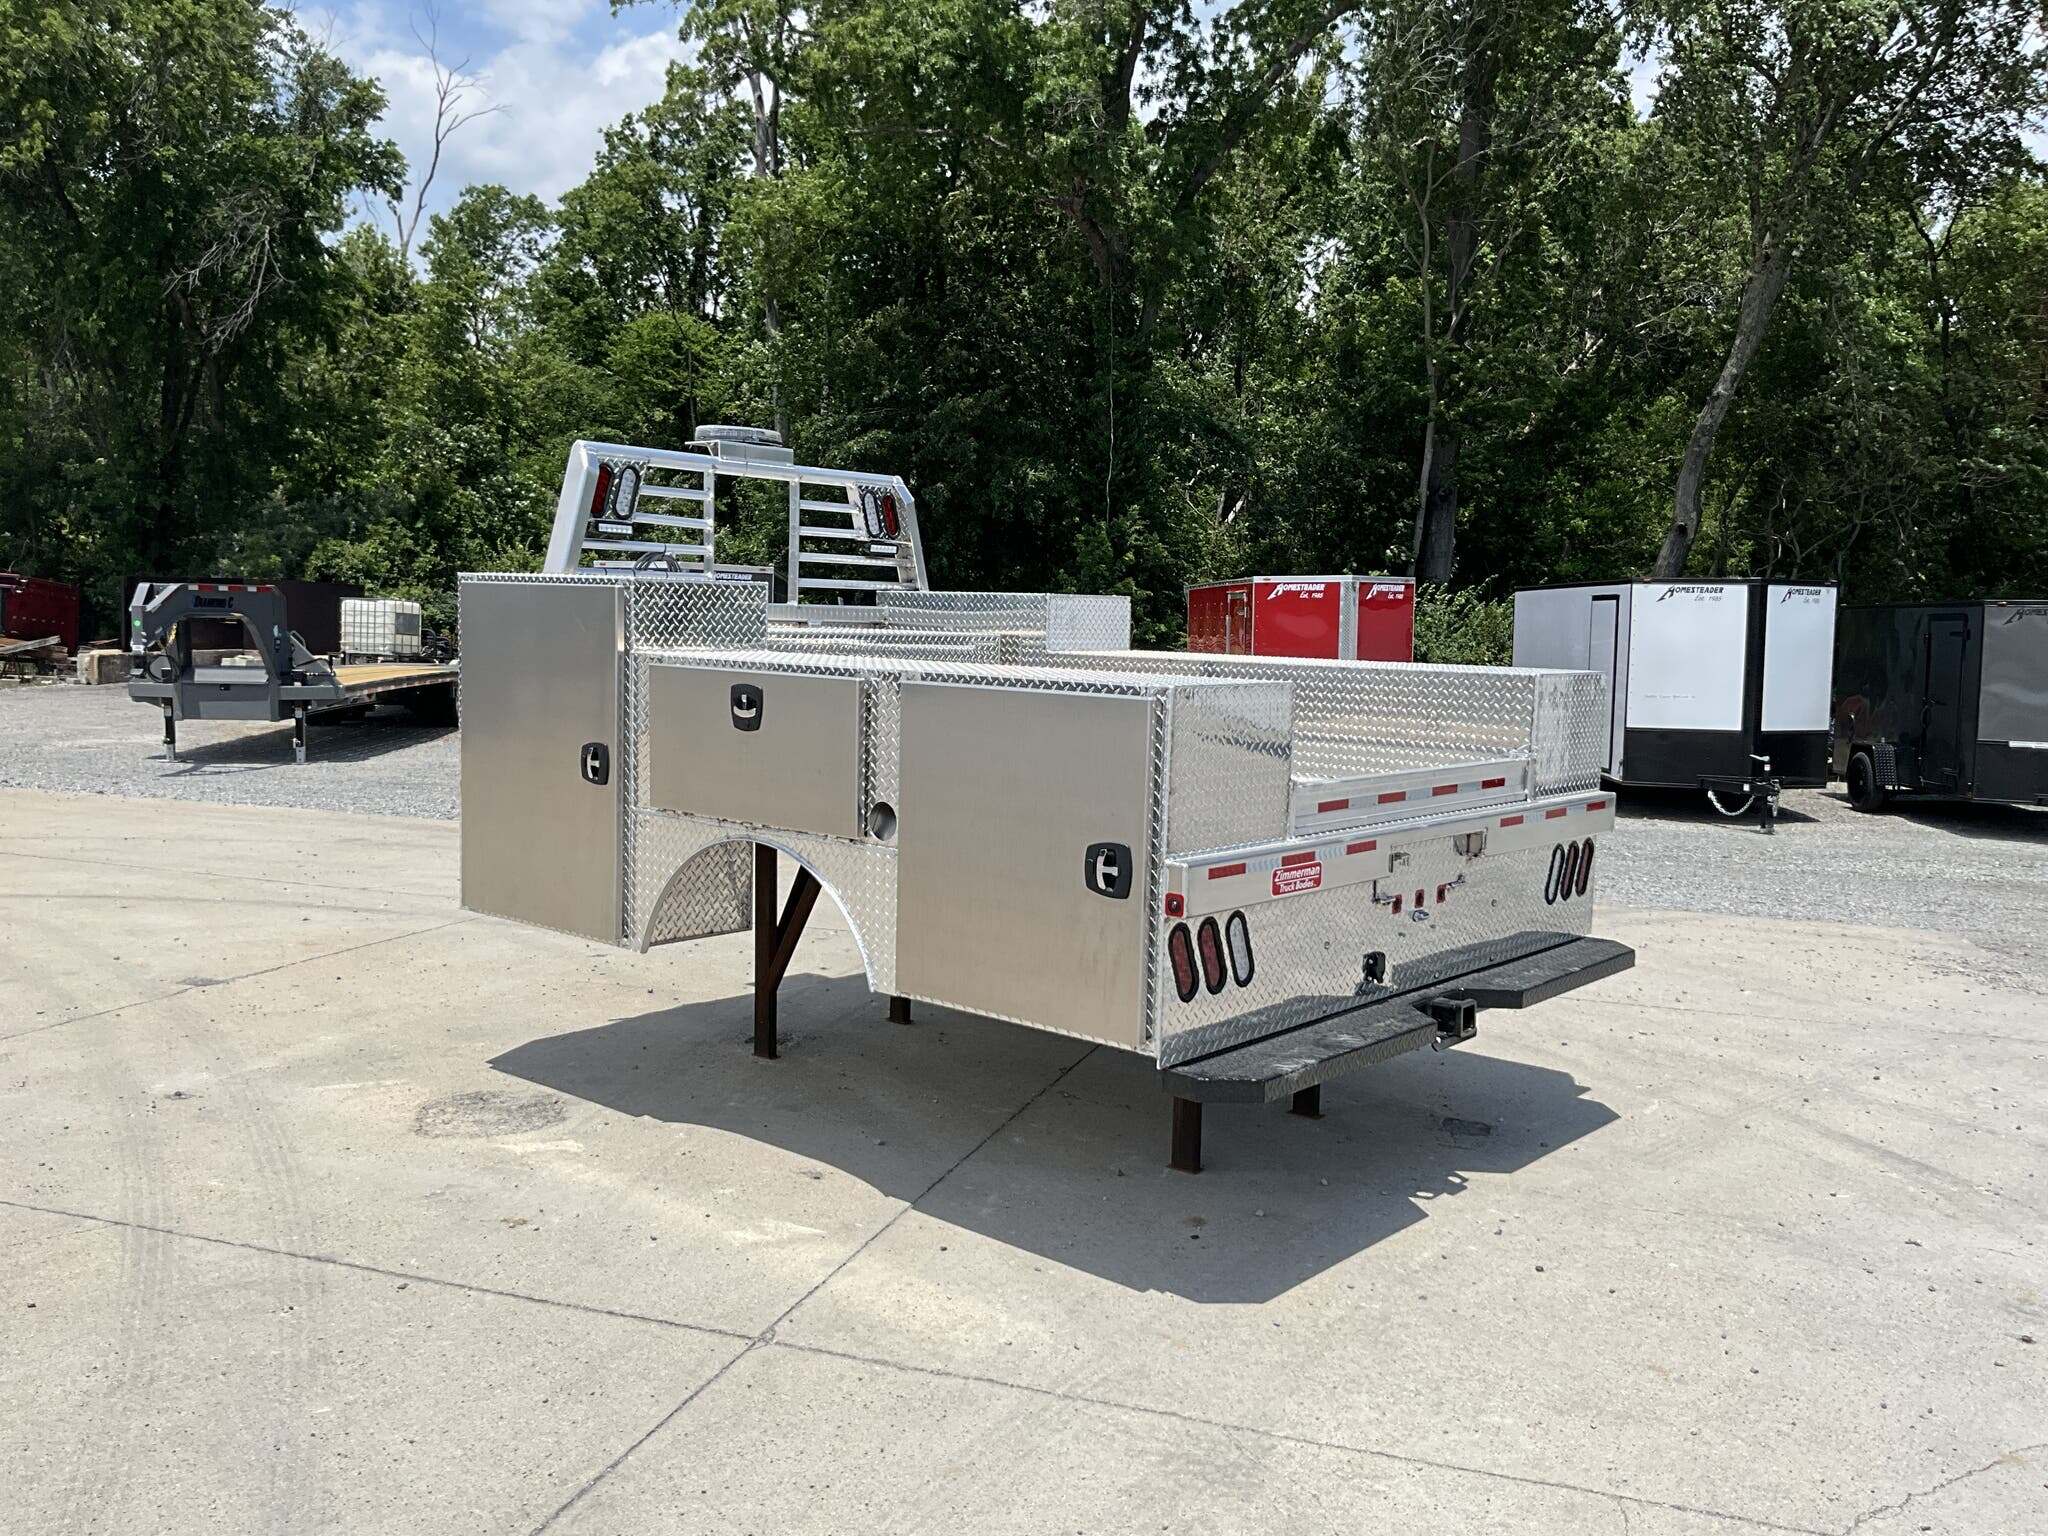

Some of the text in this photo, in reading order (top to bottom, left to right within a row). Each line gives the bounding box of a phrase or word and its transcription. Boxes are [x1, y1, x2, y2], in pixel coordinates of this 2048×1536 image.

[714, 572, 752, 580] OMESTEADER
[1266, 583, 1326, 600] HOMESTEADER
[1656, 584, 1724, 602] HOMESTEADER
[1274, 866, 1320, 882] Zimmerman
[1279, 879, 1314, 893] Truck Bodies
